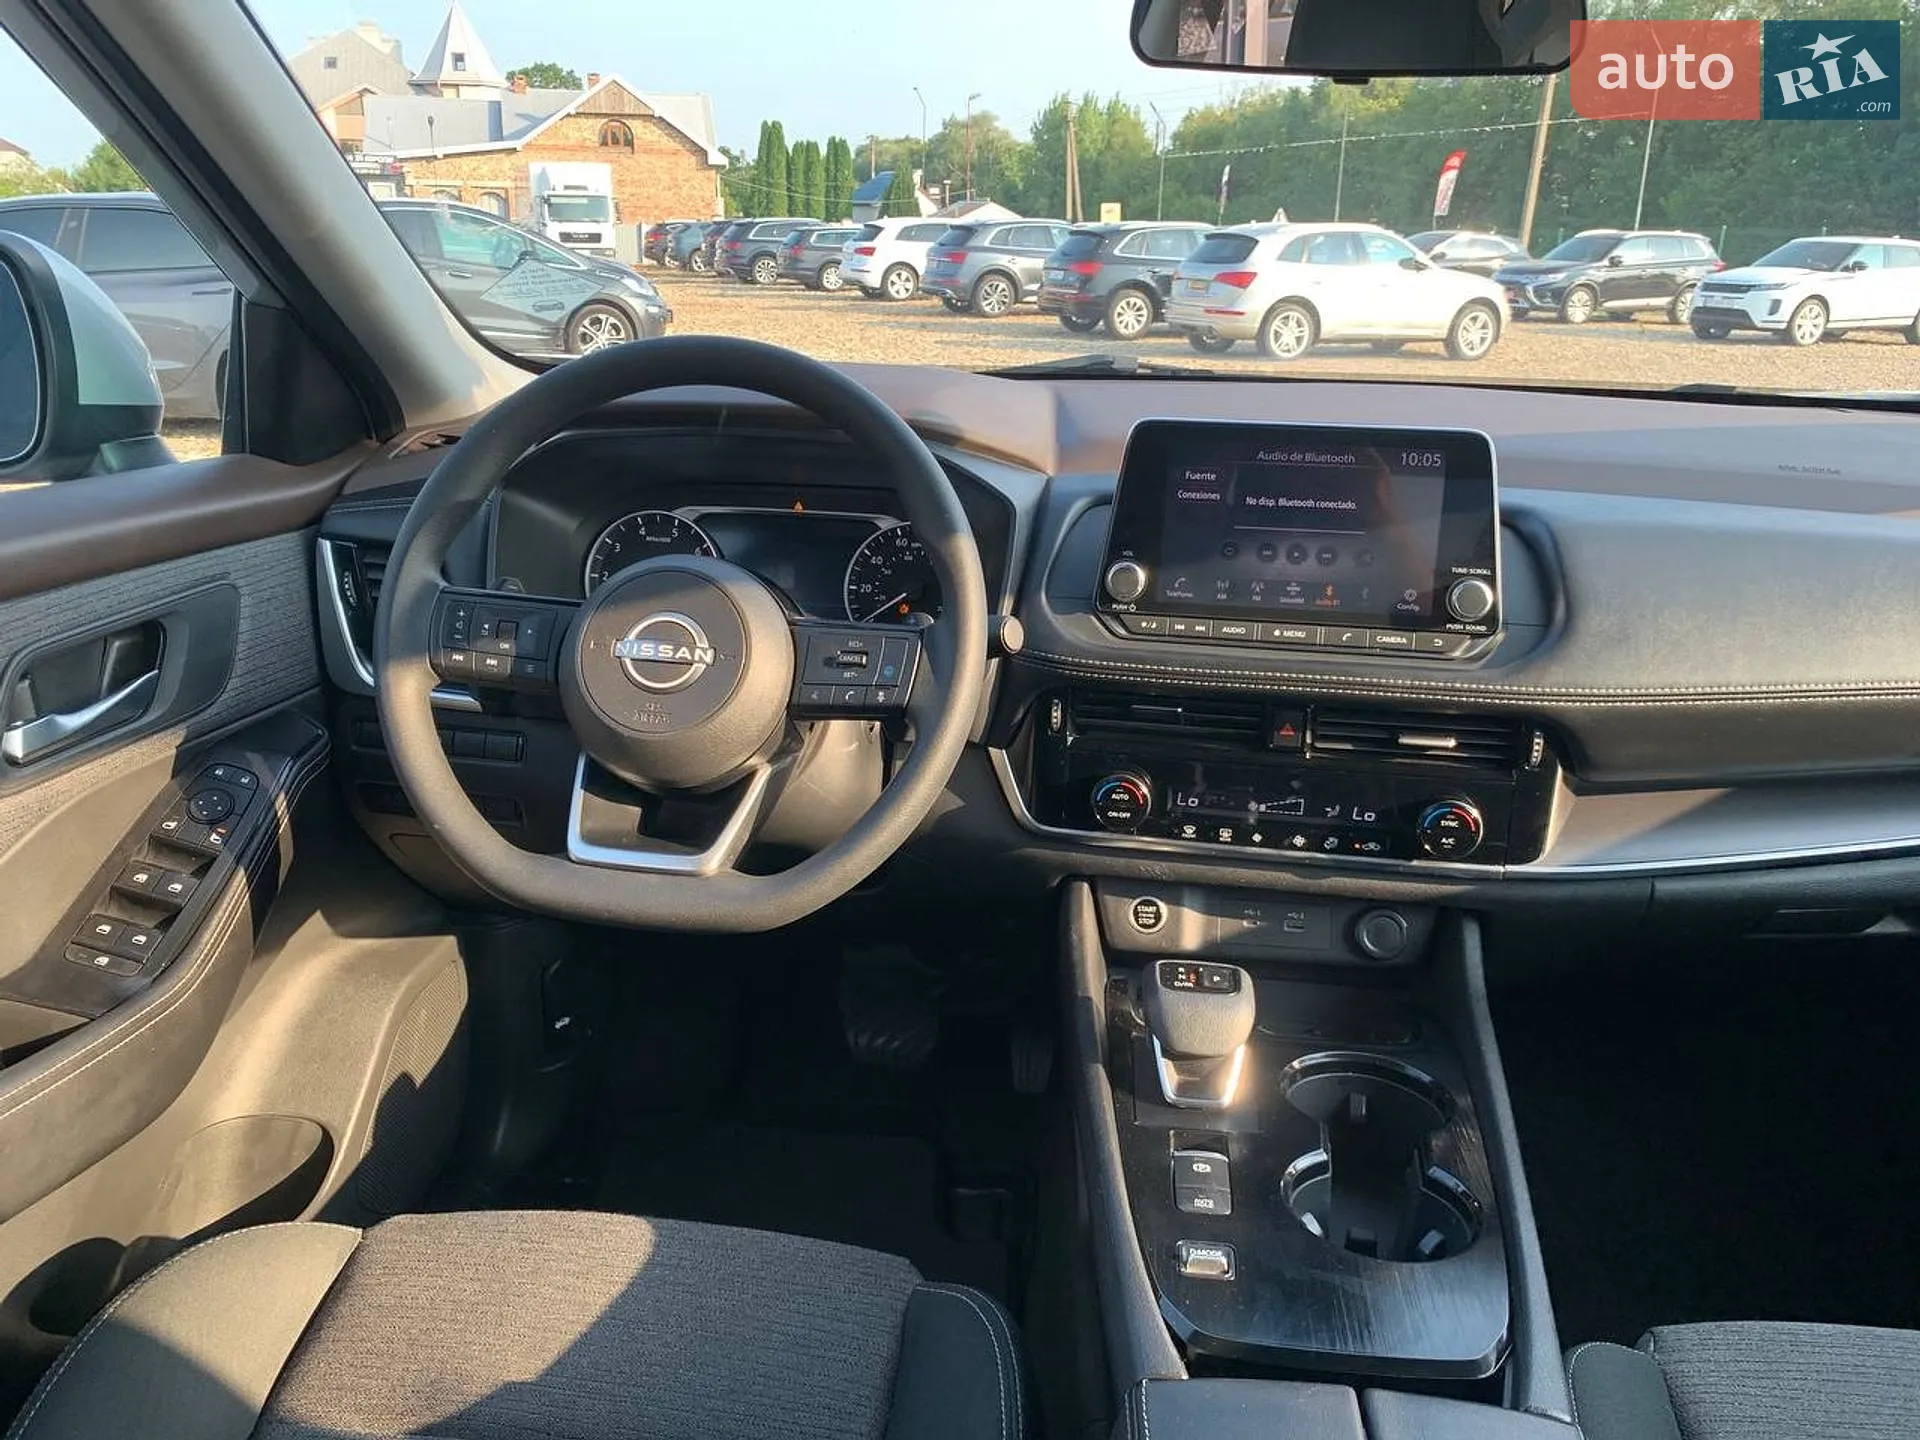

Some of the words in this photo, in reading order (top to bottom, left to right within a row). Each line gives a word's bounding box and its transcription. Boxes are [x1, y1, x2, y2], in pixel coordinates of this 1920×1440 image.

[1257, 451, 1287, 462] Audio
[1290, 452, 1303, 462] de
[1305, 453, 1355, 464] Bluetooth
[1401, 452, 1442, 467] 10:05
[1185, 470, 1216, 481] Fuente
[1177, 489, 1221, 502] Conexiones
[1246, 497, 1257, 506] No
[1278, 498, 1315, 508] Bluetooth
[671, 528, 679, 537] 5
[896, 538, 908, 547] 60
[614, 543, 621, 552] 3
[871, 556, 884, 565] 40
[602, 571, 609, 580] 2
[860, 584, 873, 593] 20
[1222, 626, 1246, 635] AUDIO
[1283, 628, 1306, 638] MENU
[1375, 635, 1406, 644] CAMERA
[616, 641, 711, 664] NISSAN
[1111, 793, 1129, 801] AUTO
[1177, 792, 1198, 807] Lo
[1352, 806, 1376, 822] Lo
